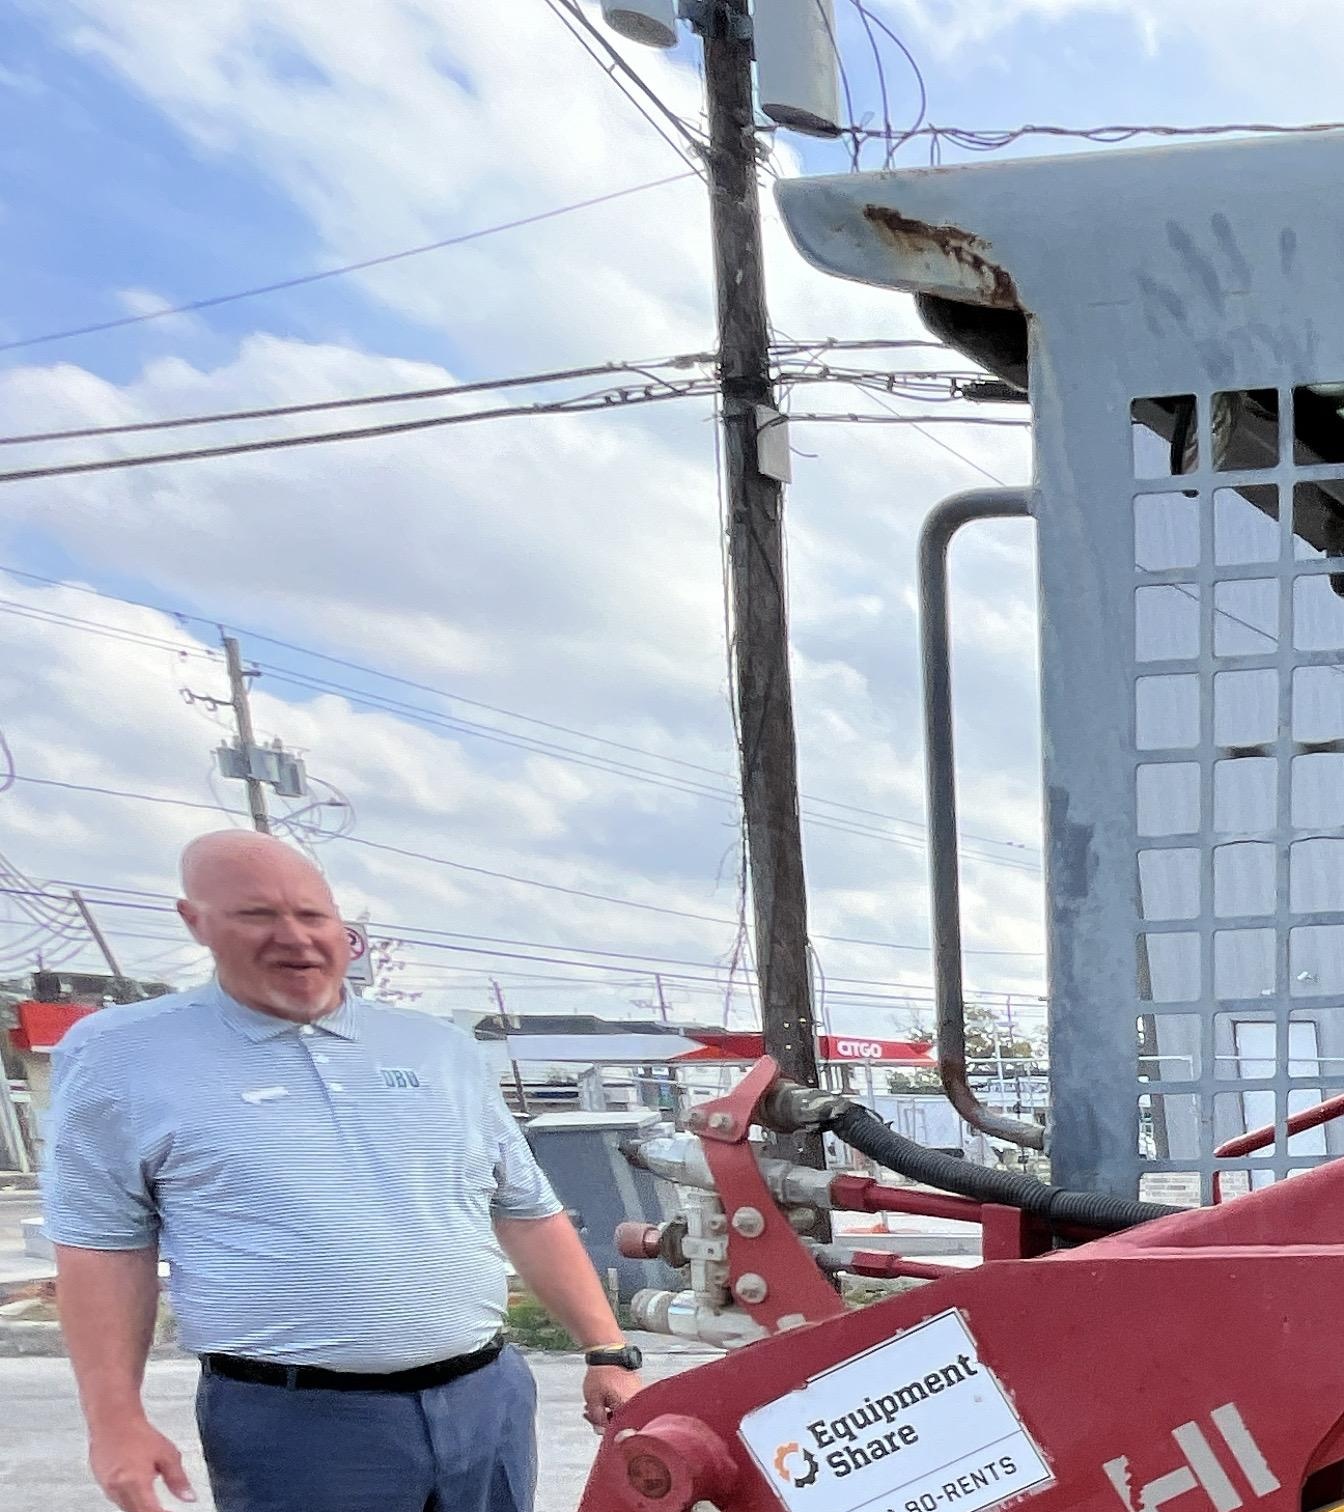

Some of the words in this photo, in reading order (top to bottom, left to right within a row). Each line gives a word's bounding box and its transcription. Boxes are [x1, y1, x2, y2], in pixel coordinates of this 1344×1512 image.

[836, 1040, 883, 1059] CITGO
[806, 1353, 978, 1449] Equipment
[825, 1423, 920, 1478] Share
